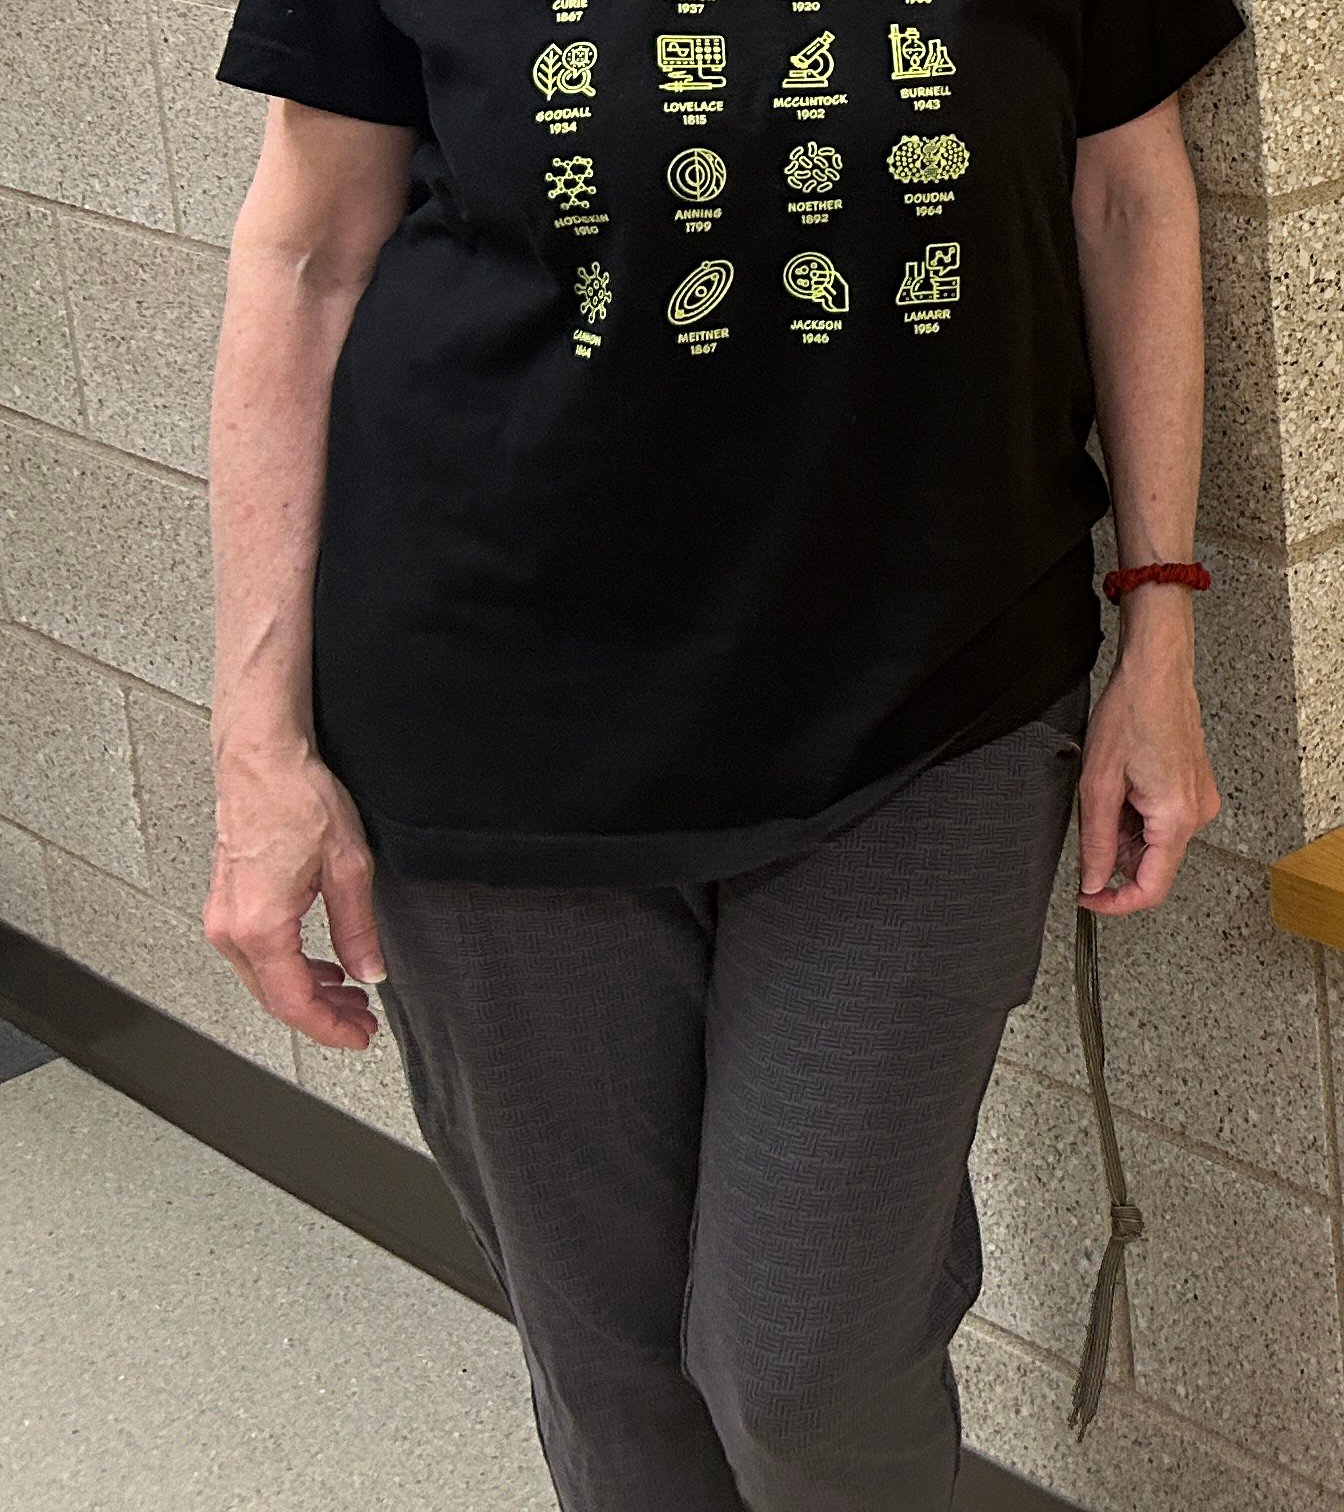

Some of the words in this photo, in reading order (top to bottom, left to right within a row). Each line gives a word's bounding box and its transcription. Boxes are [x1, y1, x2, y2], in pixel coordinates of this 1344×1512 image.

[792, 2, 820, 12] 1920
[900, 86, 951, 98] BURNELL
[664, 101, 723, 112] LOVELACE
[774, 94, 848, 108] MCCLINTOCK
[914, 99, 940, 111] 1943
[536, 107, 591, 123] GOODALL
[683, 115, 707, 125] 1815
[797, 109, 825, 120] 1902
[904, 191, 954, 204] DOUDNA
[788, 199, 842, 212] NOETHER
[916, 205, 942, 216] 1964
[675, 208, 722, 220] ANNING
[802, 214, 828, 224] 1892
[686, 221, 711, 232] 1799
[905, 309, 950, 323] LAMARR
[791, 320, 842, 330] JACKSON
[678, 328, 729, 343] MEITNER
[803, 333, 829, 343] 1946
